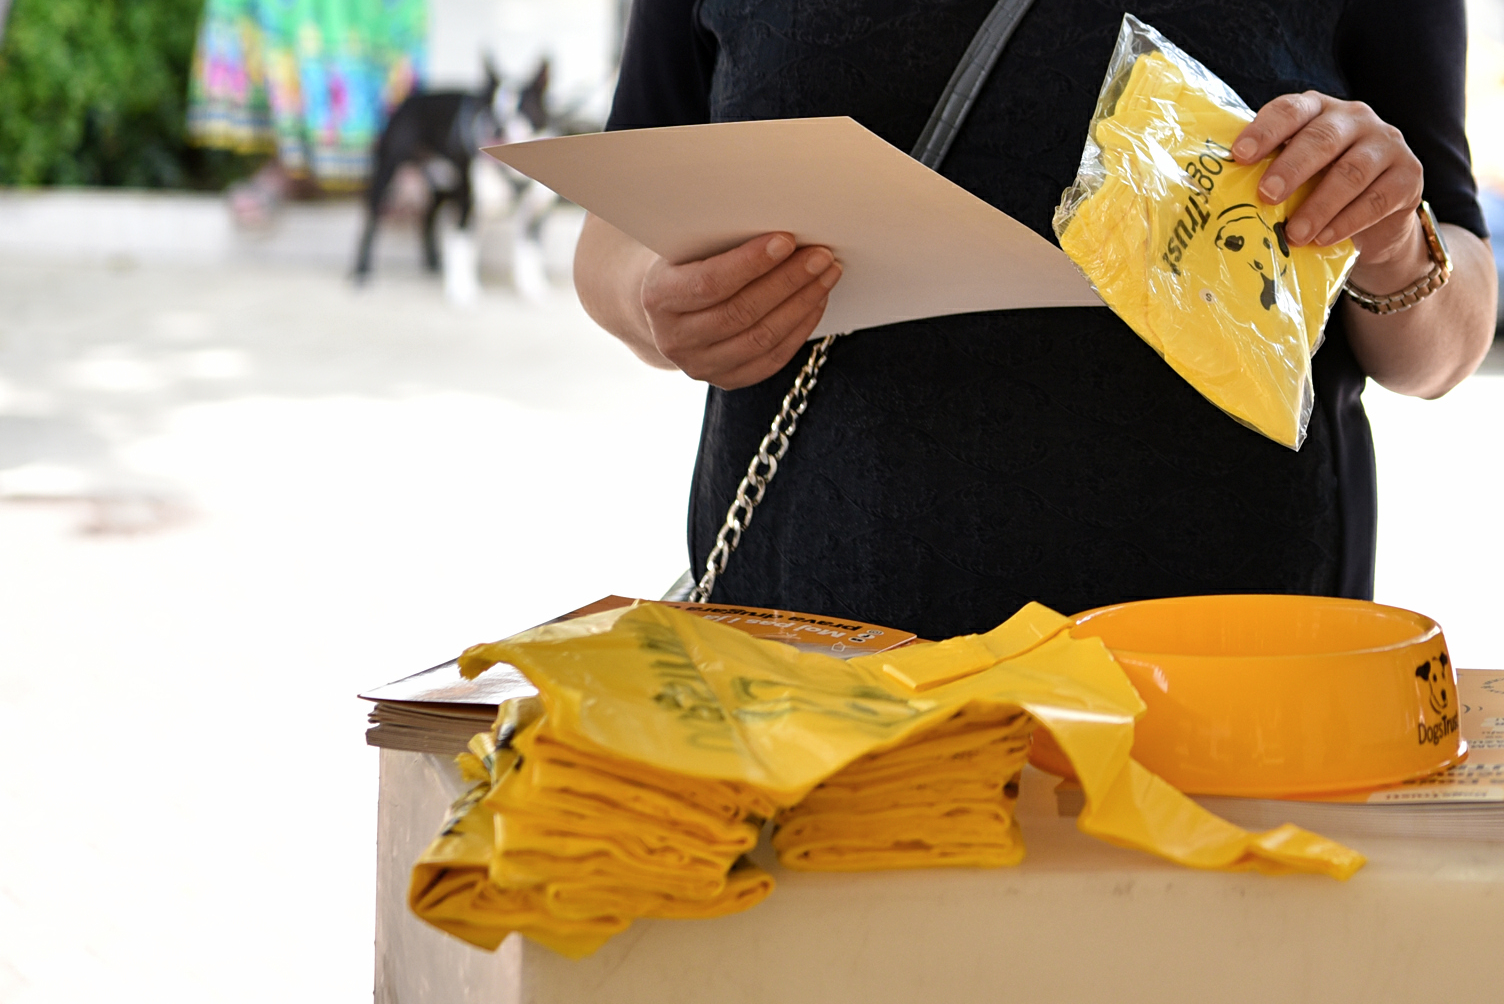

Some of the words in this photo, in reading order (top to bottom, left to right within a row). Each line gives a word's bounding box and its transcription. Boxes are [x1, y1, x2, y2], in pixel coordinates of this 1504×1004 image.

[685, 606, 784, 620] drugara
[744, 617, 796, 630] pas
[788, 615, 863, 632] prava
[795, 624, 846, 639] Moj
